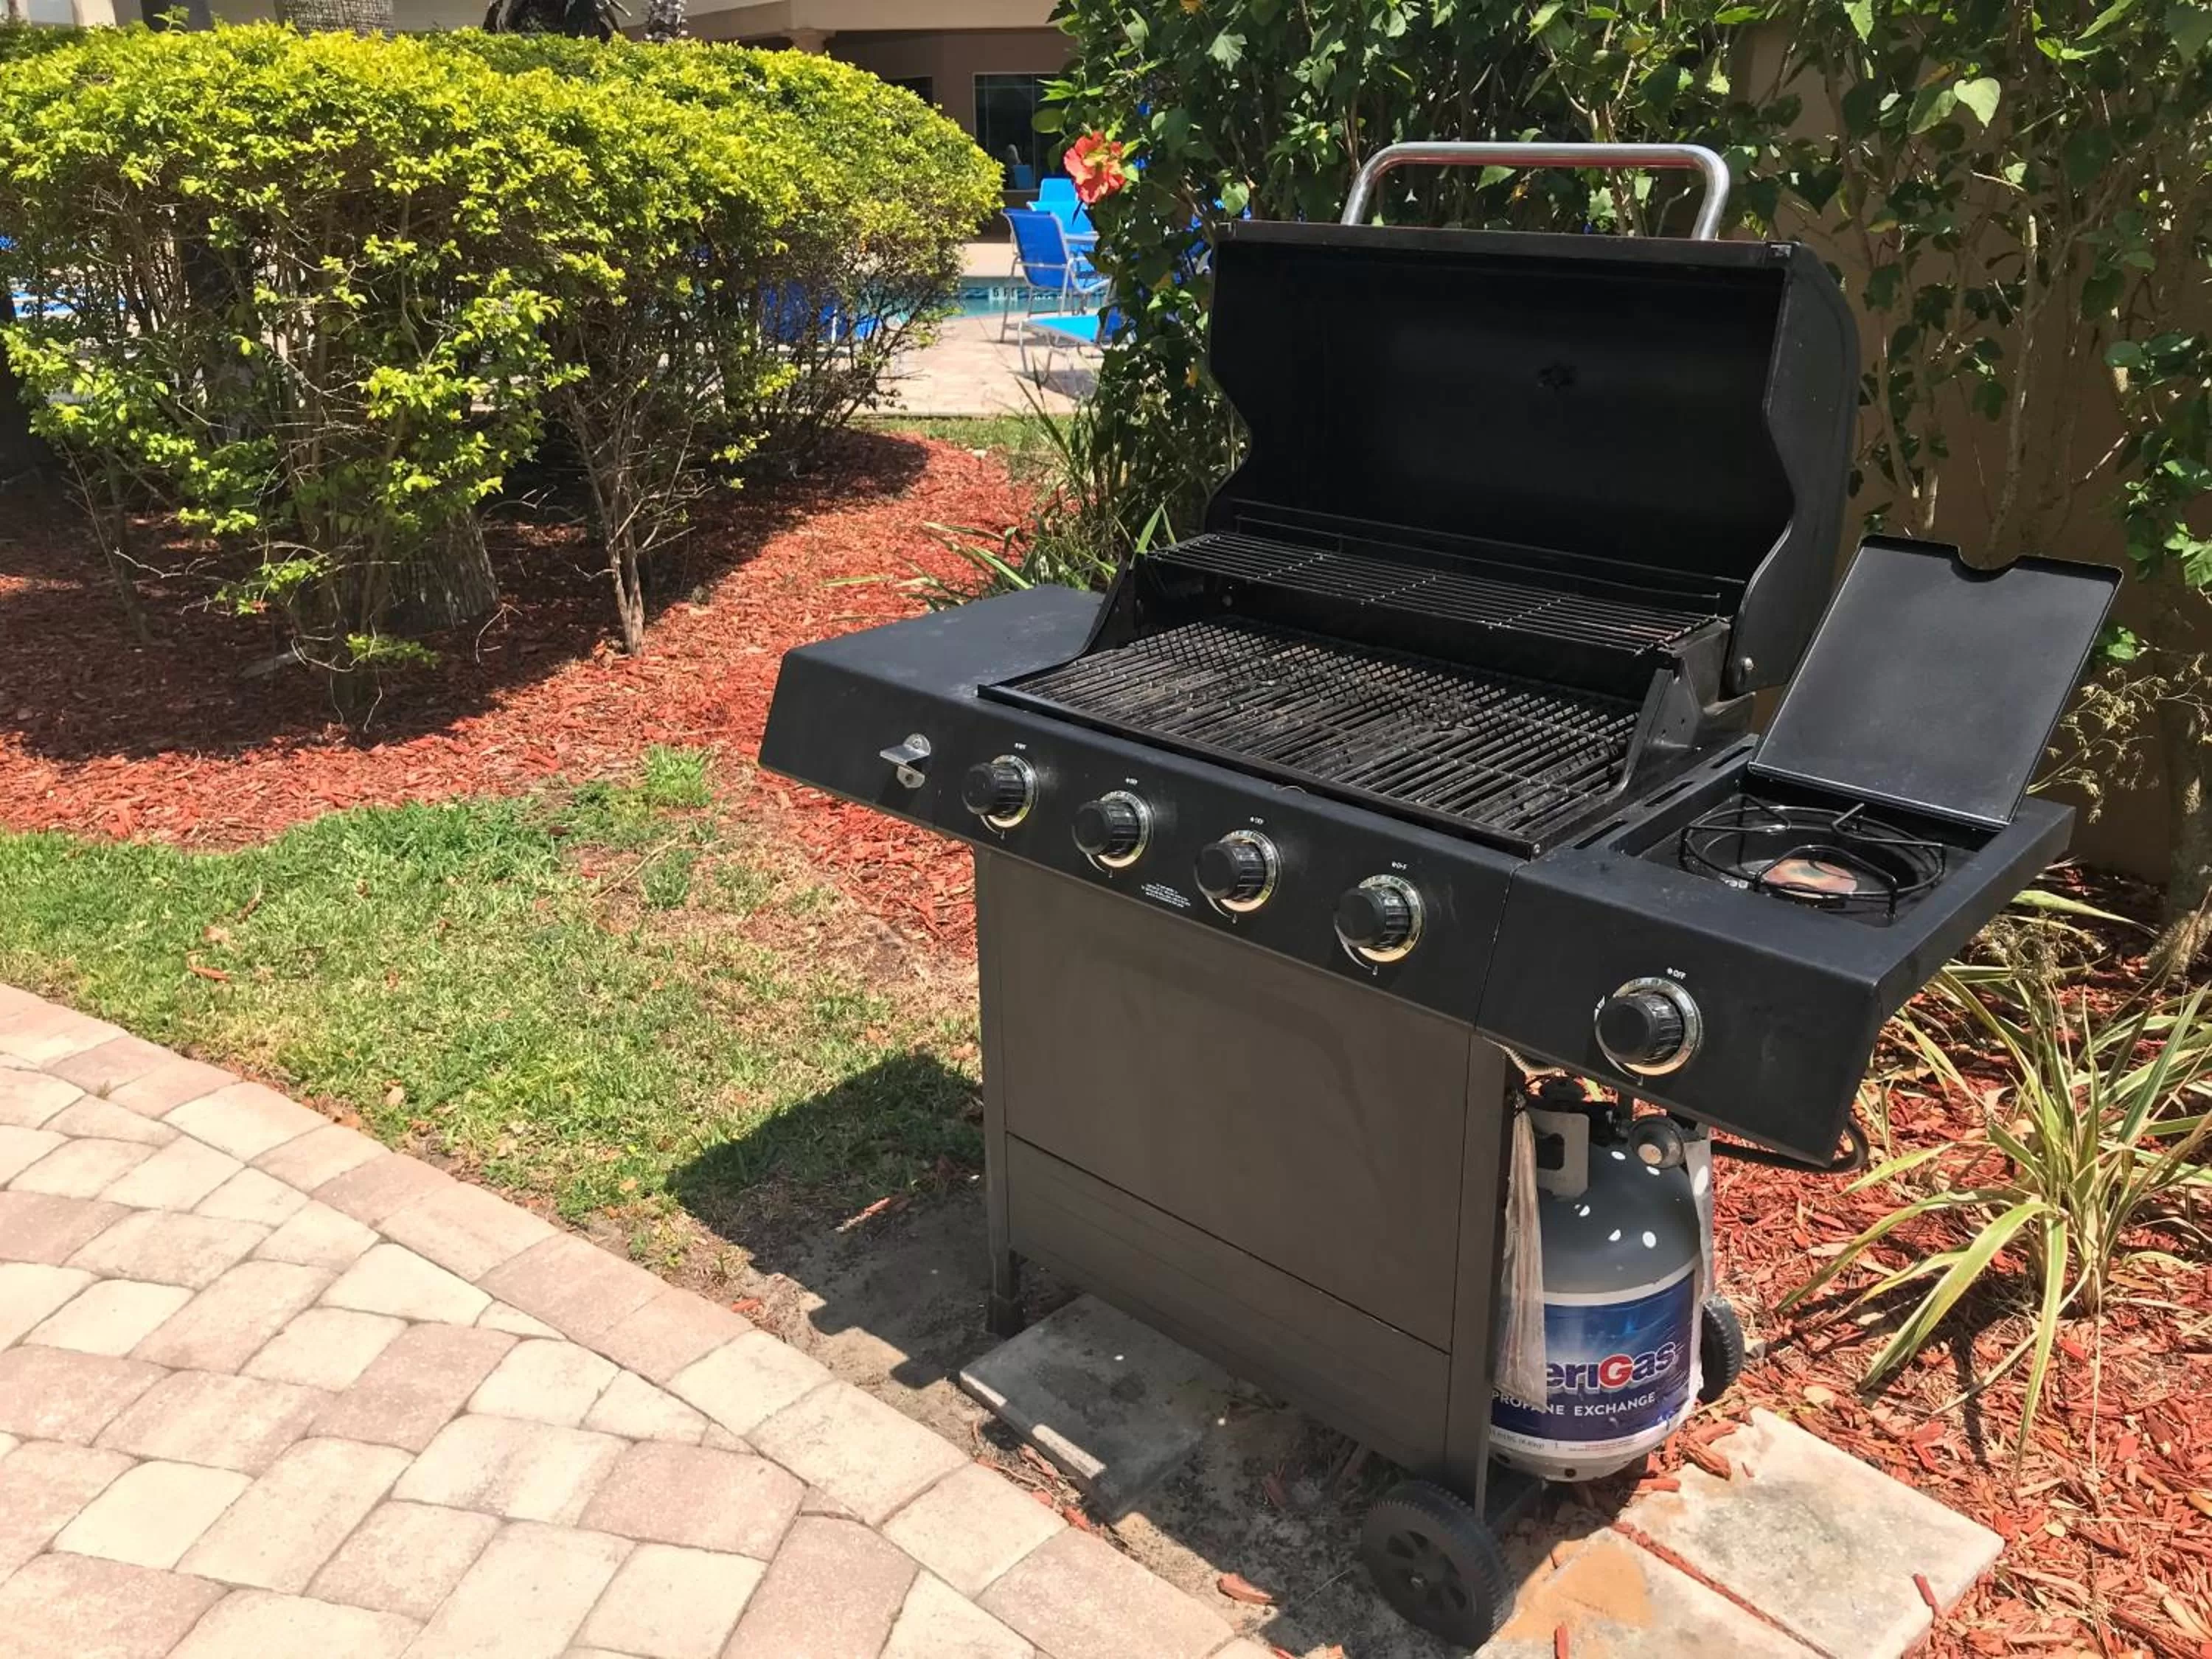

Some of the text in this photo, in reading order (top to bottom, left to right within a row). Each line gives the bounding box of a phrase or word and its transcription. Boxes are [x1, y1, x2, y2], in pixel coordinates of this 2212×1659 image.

[1673, 970, 1686, 980] OFF
[1546, 1341, 1676, 1391] eriGas
[1492, 1391, 1655, 1416] PRONE EXCHANGE
